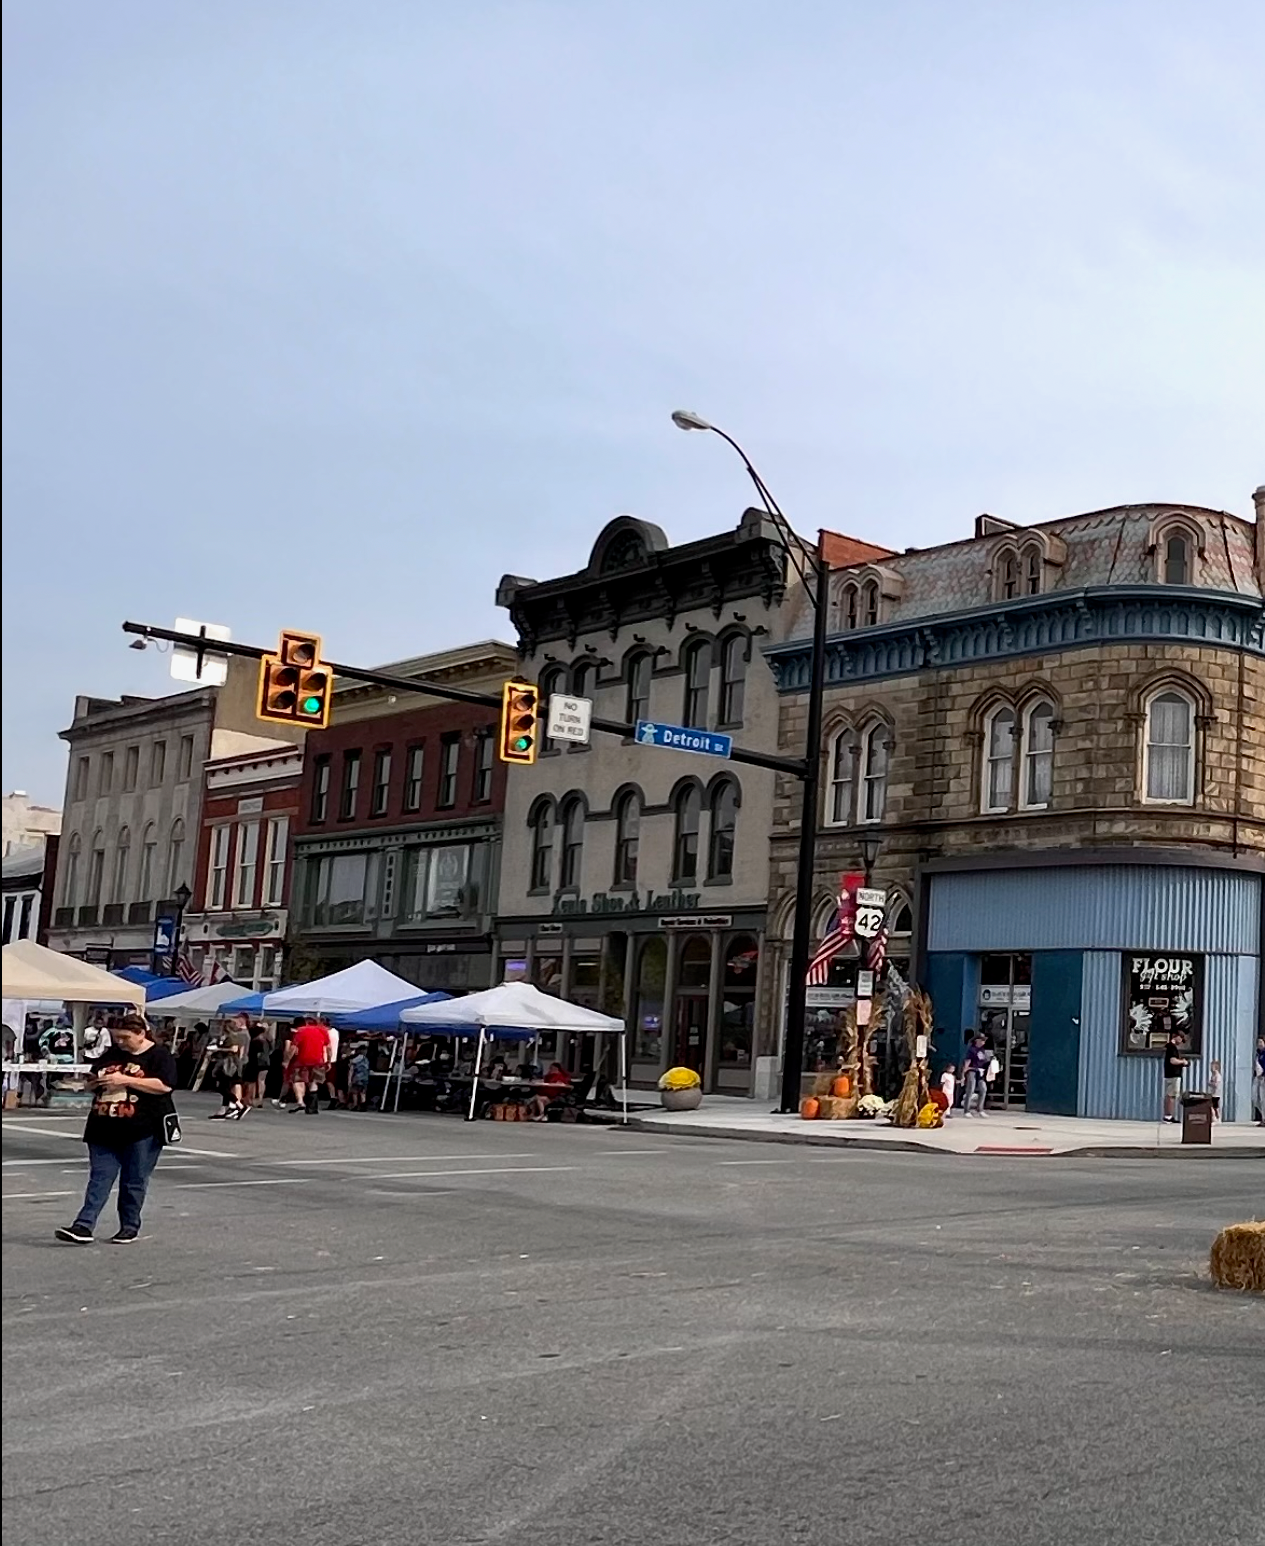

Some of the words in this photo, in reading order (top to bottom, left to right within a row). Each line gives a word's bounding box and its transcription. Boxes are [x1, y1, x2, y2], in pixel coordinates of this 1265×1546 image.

[564, 702, 578, 711] NO
[559, 713, 581, 724] TURN
[553, 724, 565, 733] ON
[567, 726, 583, 736] RED
[663, 730, 710, 750] Detroit
[645, 888, 701, 911] Leather
[859, 892, 885, 904] NORTH
[858, 914, 881, 931] 42
[1132, 958, 1193, 974] FLOUR
[1161, 969, 1187, 985] shop
